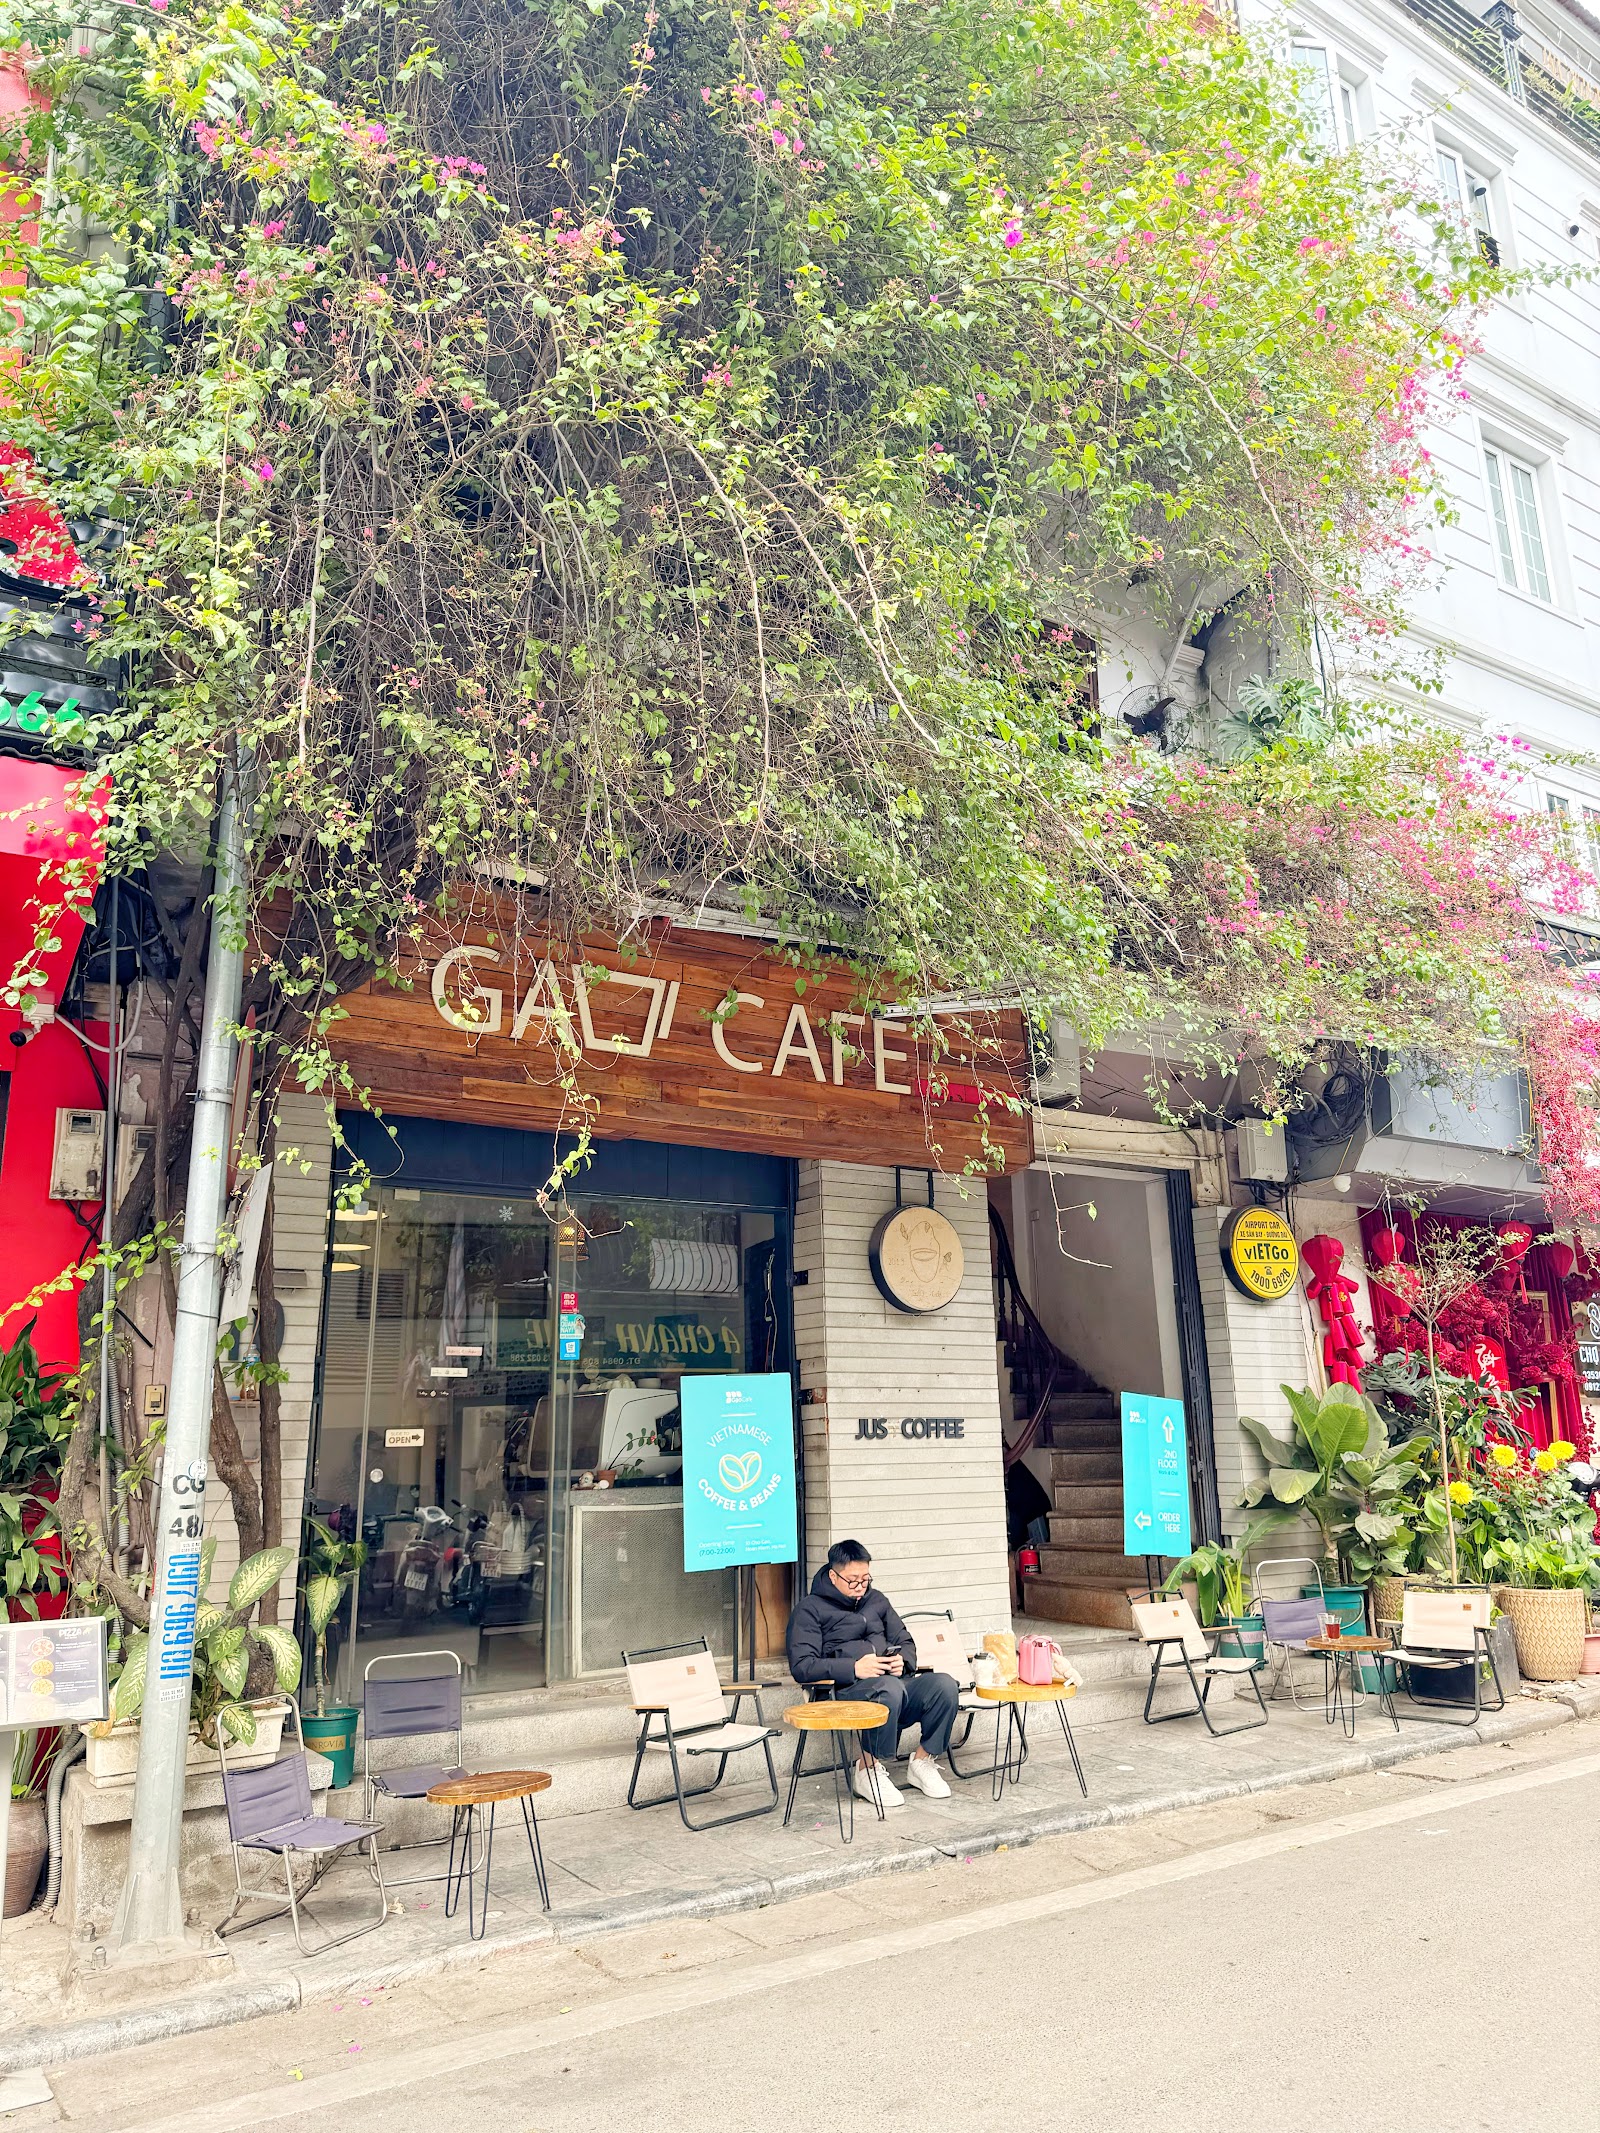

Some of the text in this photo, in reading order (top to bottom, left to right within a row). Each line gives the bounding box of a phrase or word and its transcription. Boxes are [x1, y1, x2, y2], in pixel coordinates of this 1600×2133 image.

[710, 992, 912, 1096] CAFE
[1245, 1220, 1281, 1229] AIRPORT CAR
[1251, 1267, 1291, 1290] 1900 6928
[901, 1417, 965, 1440] COFFEE
[388, 1436, 411, 1444] OPEN
[706, 1424, 773, 1448] VIETNAMESE
[1163, 1449, 1178, 1459] 2ND
[1157, 1458, 1178, 1469] FLOOR
[698, 1473, 782, 1511] COFFEE & BEANS
[1158, 1512, 1181, 1523] ORDER
[1164, 1523, 1181, 1534] HERE
[699, 1541, 722, 1549] Opening
[166, 1553, 201, 1599] 0917
[58, 1627, 82, 1638] PIZZA
